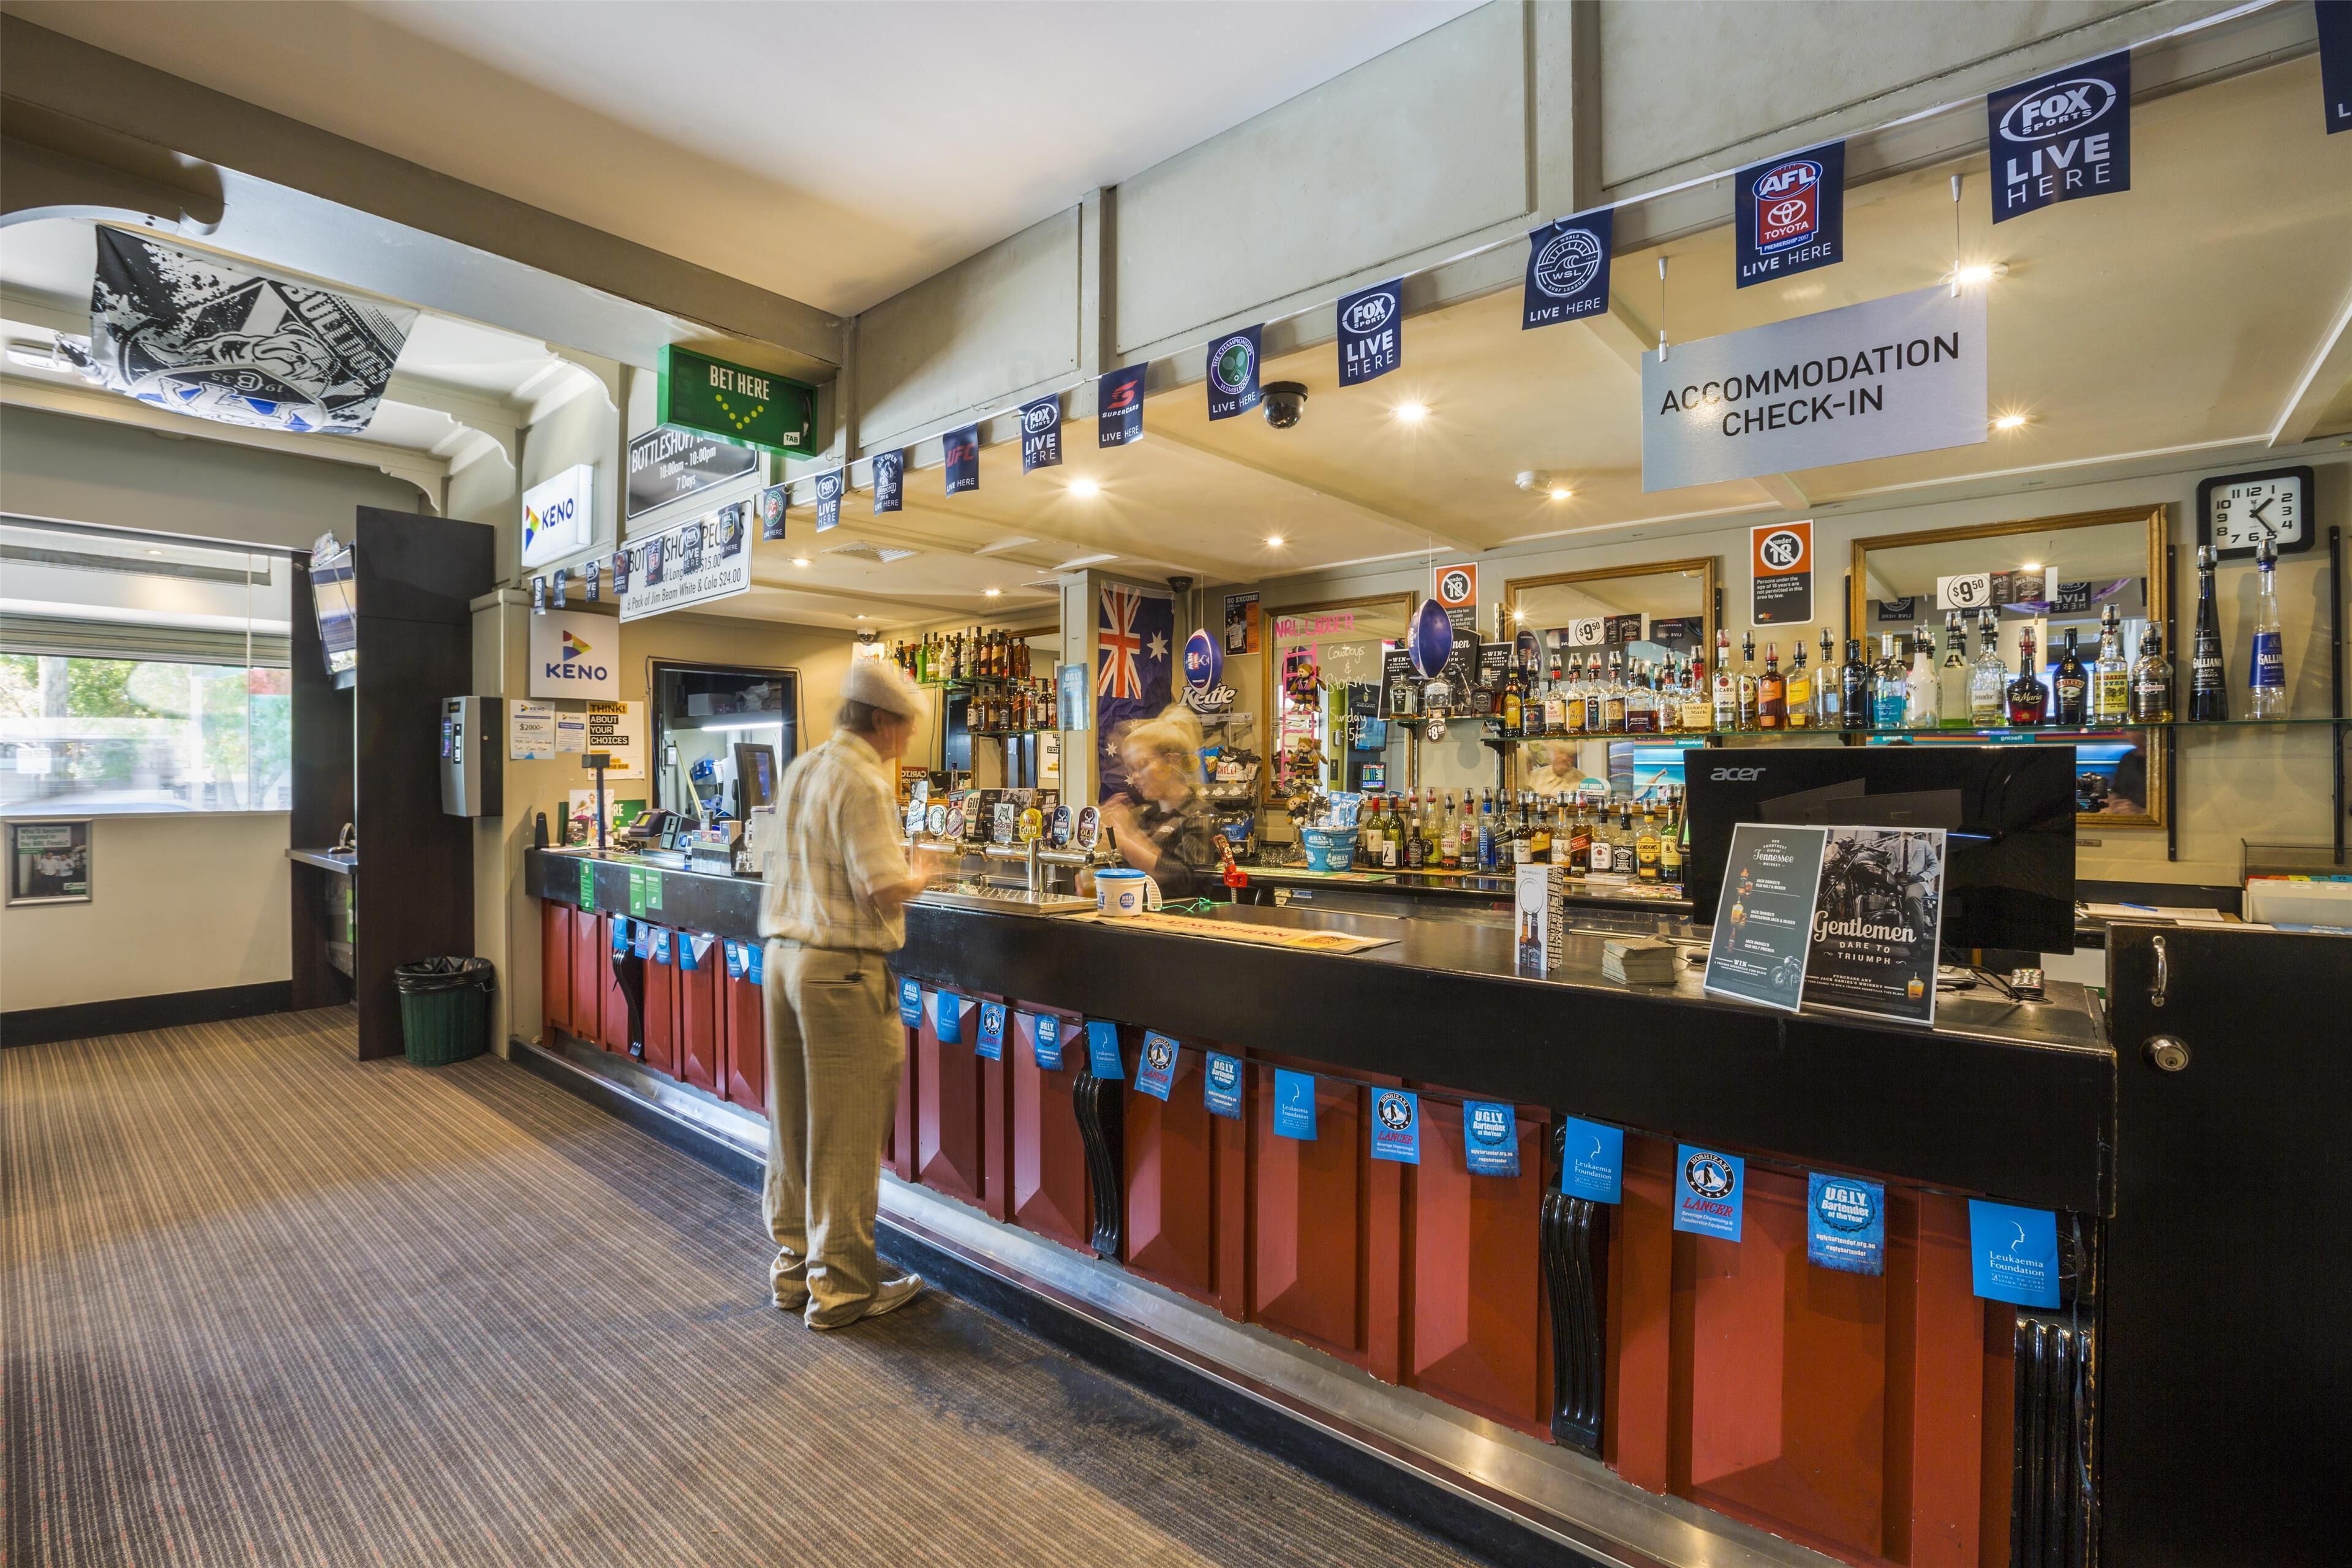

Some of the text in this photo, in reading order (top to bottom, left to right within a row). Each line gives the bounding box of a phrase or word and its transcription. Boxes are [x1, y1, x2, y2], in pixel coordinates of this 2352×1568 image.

[2022, 85, 2092, 127] FOX
[2022, 108, 2092, 135] SPORTS
[2007, 132, 2110, 186] LIVE
[1760, 166, 1816, 196] AFL
[2008, 162, 2111, 208] HERE
[1560, 234, 1580, 243] WORLD
[1764, 221, 1809, 240] TOYOTA
[1764, 237, 1798, 251] PREMIERSHIP
[1743, 242, 1831, 277] LIVE HERE
[1553, 270, 1581, 281] WSL
[1563, 278, 1586, 292] LEAGUE
[1354, 296, 1385, 323] FOX
[1530, 297, 1600, 322] LIVE HERE
[1354, 313, 1385, 329] SPORTS
[281, 284, 393, 387] BULLDOGS
[1218, 338, 1254, 356] CHAMPIONSHIPS
[1348, 328, 1393, 362] LIVE
[1348, 349, 1393, 378] HERE
[1660, 331, 1959, 415] ACCOMMODATION
[710, 365, 769, 401] BET HERE
[1220, 374, 1250, 393] WIMBLEDON
[1213, 391, 1256, 413] LIVE HERE
[1030, 407, 1050, 426] FOX
[1102, 404, 1139, 418] SUPERCARS
[1722, 384, 1883, 437] CHECK-IN
[1030, 420, 1050, 429] SPORTS
[785, 434, 799, 443] TAB
[1102, 426, 1139, 442] LIVE HERE
[1025, 432, 1056, 455] LIVE
[660, 446, 716, 480] 10:00am 10:00pm
[884, 454, 898, 464] OPEN
[946, 443, 975, 467] UFC
[1025, 448, 1056, 467] HERE
[682, 474, 696, 489] Days
[821, 479, 835, 492] FOX
[946, 477, 975, 492] LIVE HERE
[2232, 489, 2240, 499] 11
[2247, 487, 2262, 497] 12
[2282, 492, 2293, 502] 2
[819, 499, 837, 517] LIVE
[2217, 500, 2231, 510] 10
[2282, 506, 2292, 516] 3
[542, 497, 574, 531] KENO
[818, 514, 836, 527] HERE
[2217, 513, 2228, 522] 9
[2217, 527, 2228, 536] 8
[2282, 520, 2293, 529] 4
[2231, 534, 2241, 543] 7
[2248, 532, 2260, 541] 6
[1770, 543, 1792, 564] 18
[700, 552, 722, 573] $15.00
[632, 594, 644, 610] Pack
[651, 591, 661, 605] Jim
[662, 588, 678, 601] Beam
[679, 579, 696, 598] White
[704, 573, 718, 590] Cola
[718, 567, 742, 588] $24.00
[1275, 619, 1301, 638] NRL
[1327, 643, 1365, 664] Cowboys
[2193, 657, 2222, 669] GALLIANO
[546, 663, 608, 681] KENO
[591, 704, 625, 714] THINK!
[590, 715, 618, 724] ABOUT
[1329, 707, 1368, 730] Sunday
[590, 736, 628, 745] CHOICES
[1711, 767, 1766, 782] acer
[1019, 825, 1036, 835] GOLD
[1753, 849, 1794, 863] Tennessee
[1189, 922, 1290, 938] NORTHERN
[1812, 910, 1917, 943] Gentlemen
[1876, 944, 1890, 953] TO
[1733, 959, 1747, 967] WIN
[1838, 952, 1891, 965] TRIUMPH
[1142, 1068, 1169, 1084] LANCER
[1282, 1103, 1308, 1114] Leukaemia
[1381, 1093, 1409, 1109] HOSHIZAKI
[1282, 1109, 1308, 1120] Foundation
[1472, 1120, 1506, 1132] Bartender
[1378, 1130, 1414, 1145] LANCER
[1575, 1158, 1611, 1174] Leukaemia
[1690, 1153, 1730, 1172] HOSHIZAKI
[1574, 1166, 1611, 1180] Foundation
[1682, 1197, 1734, 1218] LANCER
[1821, 1199, 1869, 1217] Bartender
[1681, 1210, 1728, 1224] Beverage Dispensing
[1681, 1217, 1733, 1231] Foodservice Equipment
[1836, 1212, 1847, 1221] the
[1847, 1215, 1863, 1224] Year
[1816, 1233, 1875, 1250] uglybartender.org.au
[1826, 1244, 1866, 1257] #uglybartender
[1990, 1250, 2044, 1268] Leukaemia
[1990, 1259, 2045, 1277] Foundation
